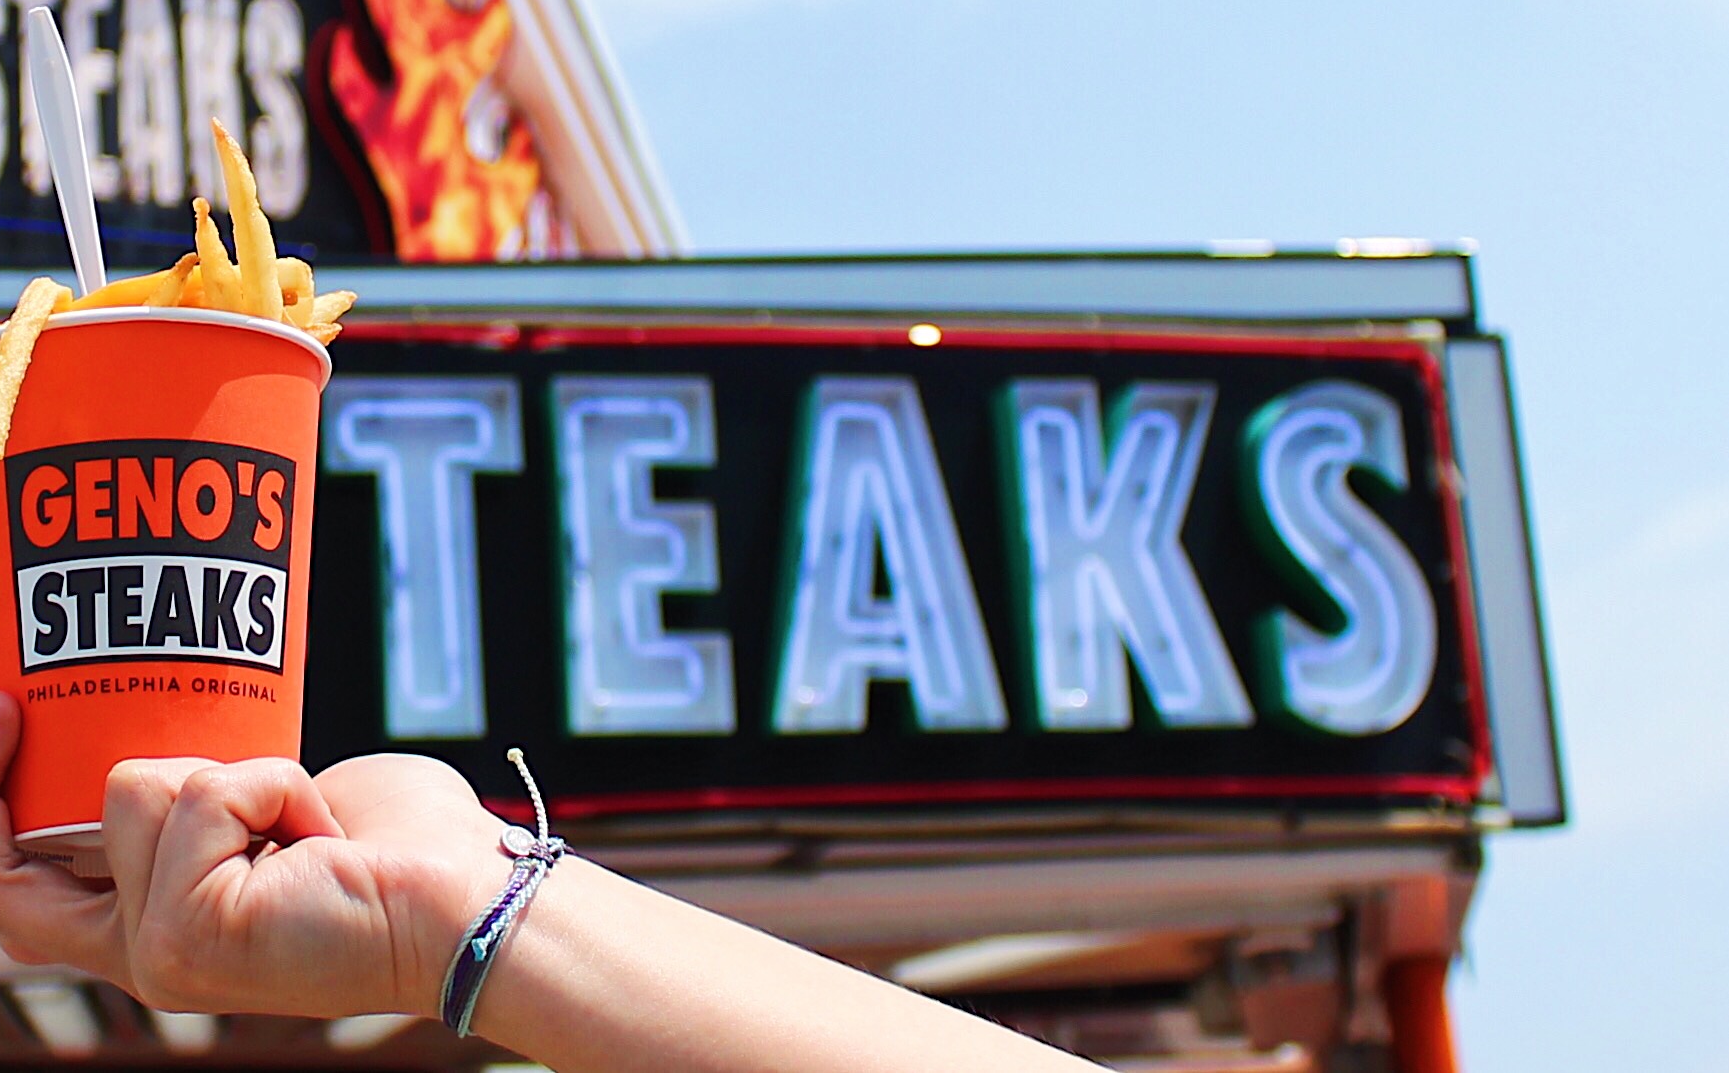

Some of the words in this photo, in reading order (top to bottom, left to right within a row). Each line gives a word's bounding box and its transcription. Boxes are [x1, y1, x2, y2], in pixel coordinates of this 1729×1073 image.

[20, 457, 286, 551] GENO'S
[322, 374, 1438, 737] TEAKS
[31, 565, 278, 656] STEAKS
[27, 677, 180, 704] PHILADELPHIA
[191, 677, 277, 703] ORIGINAL
